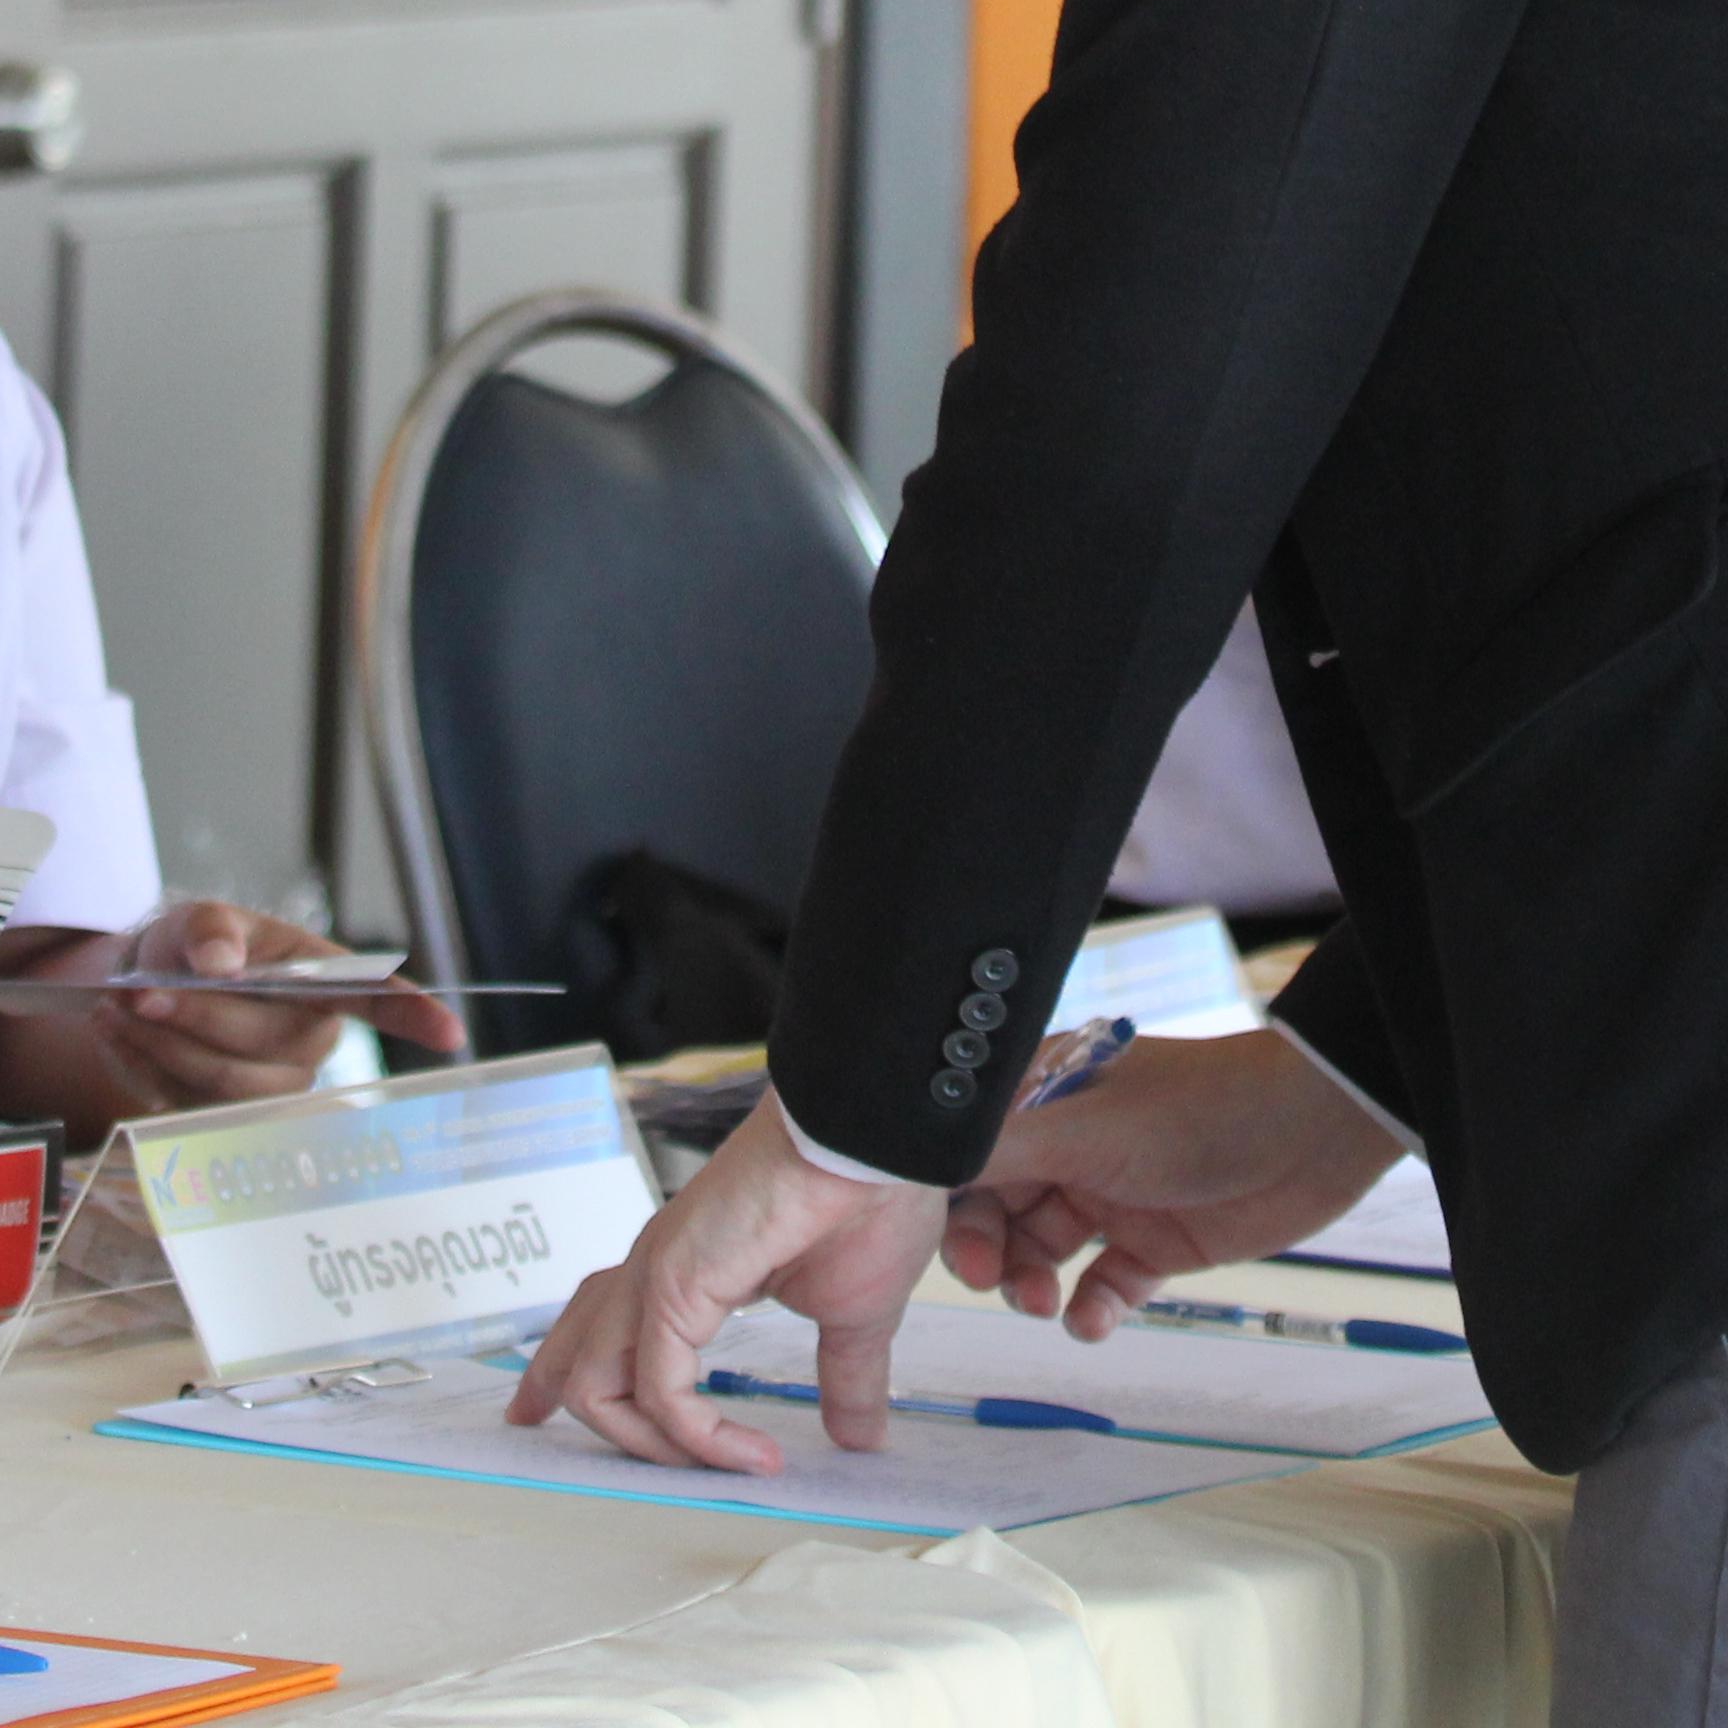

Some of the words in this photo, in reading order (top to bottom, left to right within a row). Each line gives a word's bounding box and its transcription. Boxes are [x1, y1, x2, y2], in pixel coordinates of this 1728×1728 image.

[305, 1203, 551, 1318] ผู้ทรงคุณวุฒิ
